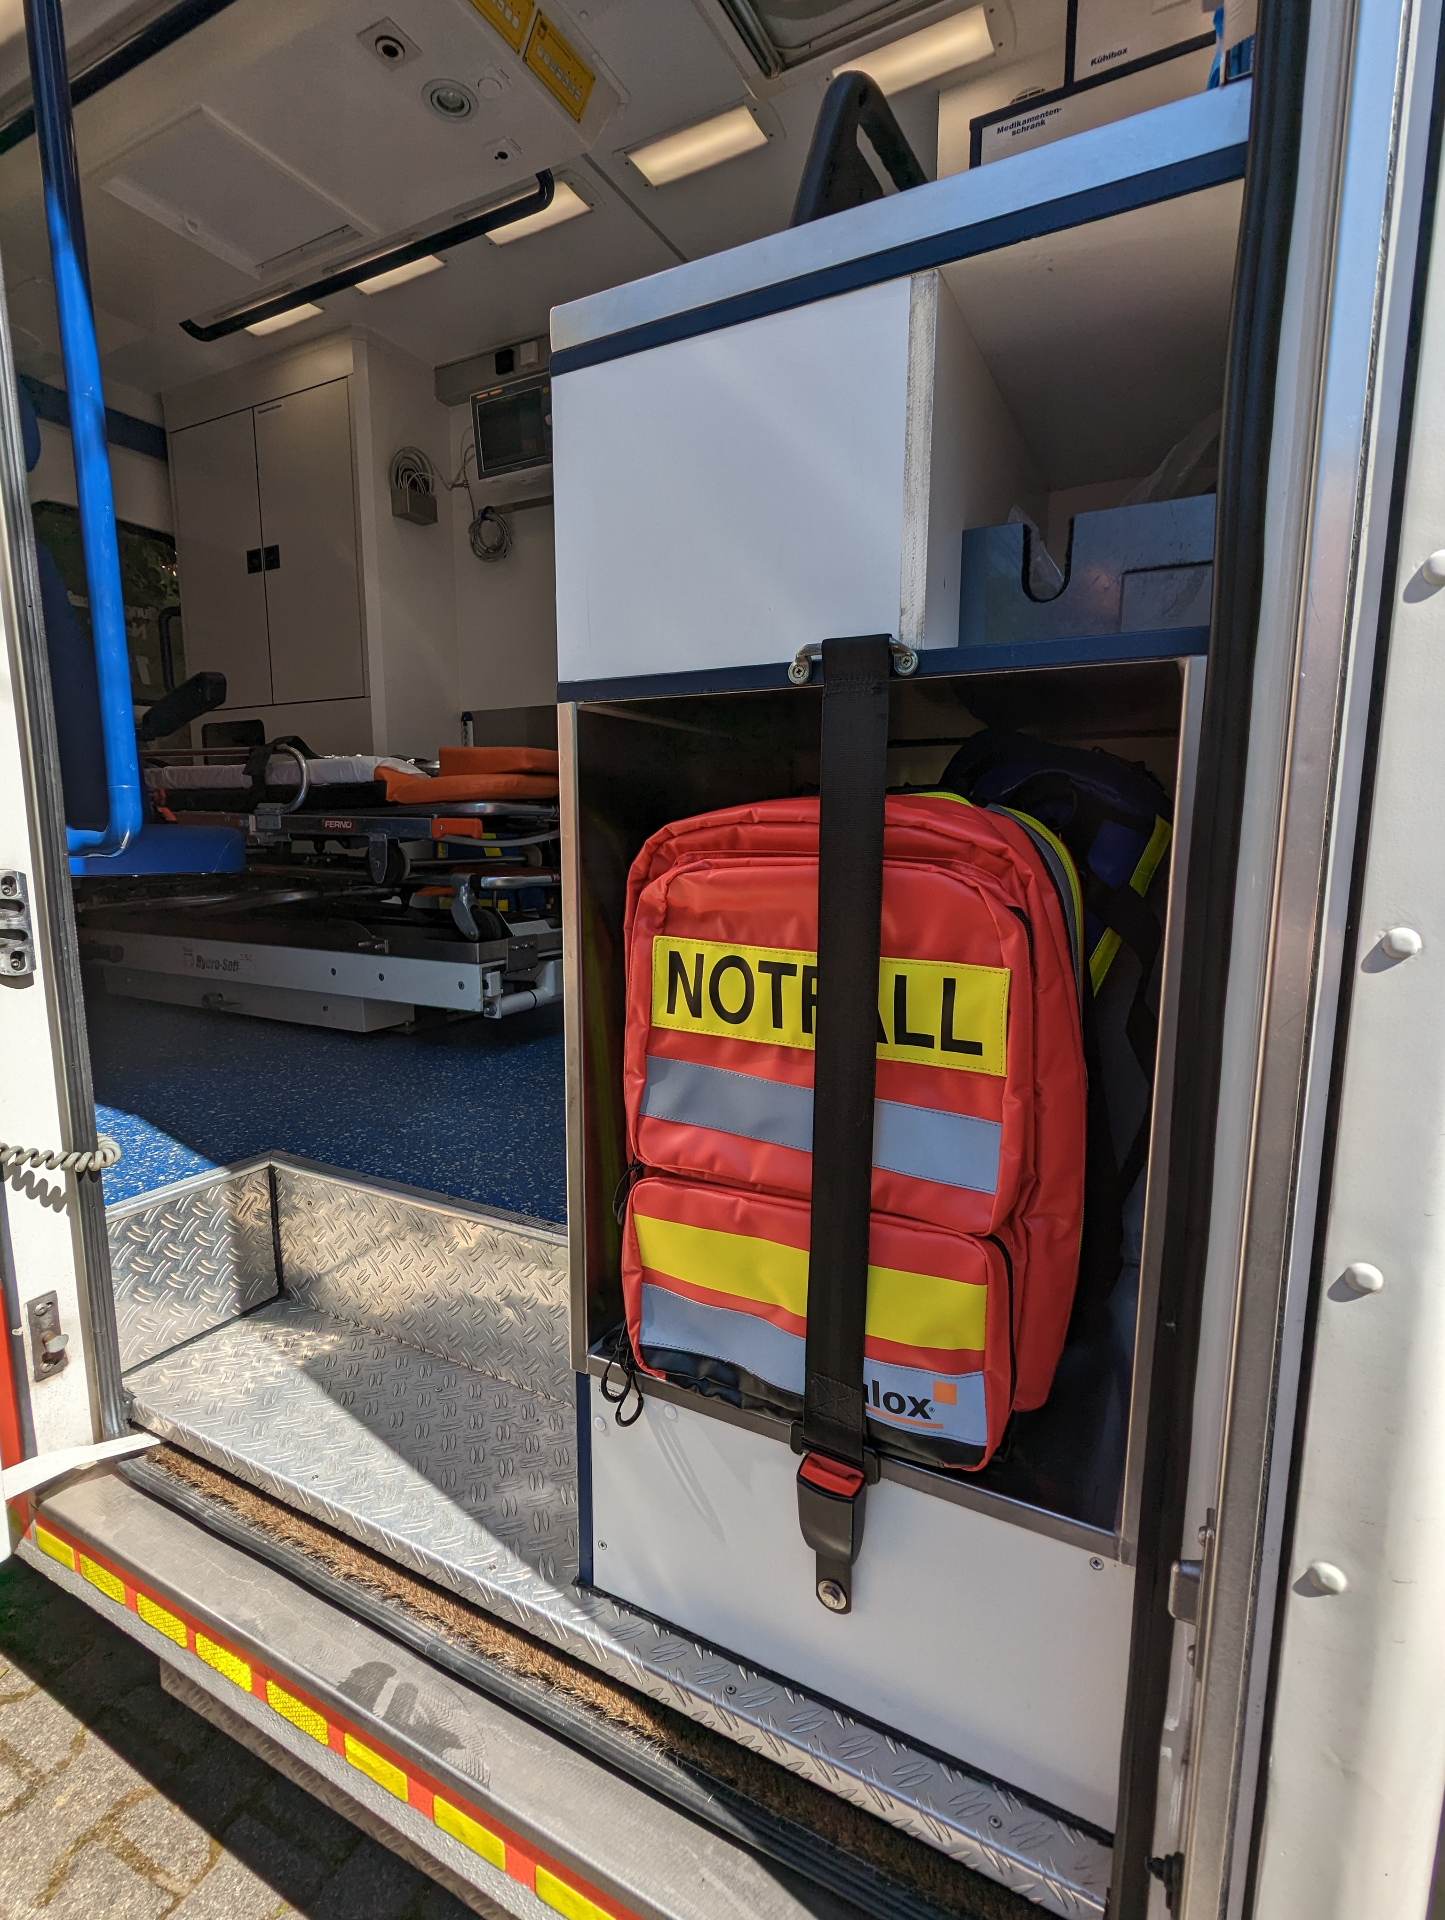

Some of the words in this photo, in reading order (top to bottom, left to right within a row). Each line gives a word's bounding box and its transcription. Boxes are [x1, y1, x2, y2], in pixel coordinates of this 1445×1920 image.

[996, 107, 1062, 134] Medikamenten-
[1011, 120, 1046, 136] schrank
[667, 950, 983, 1056] NOTFLL
